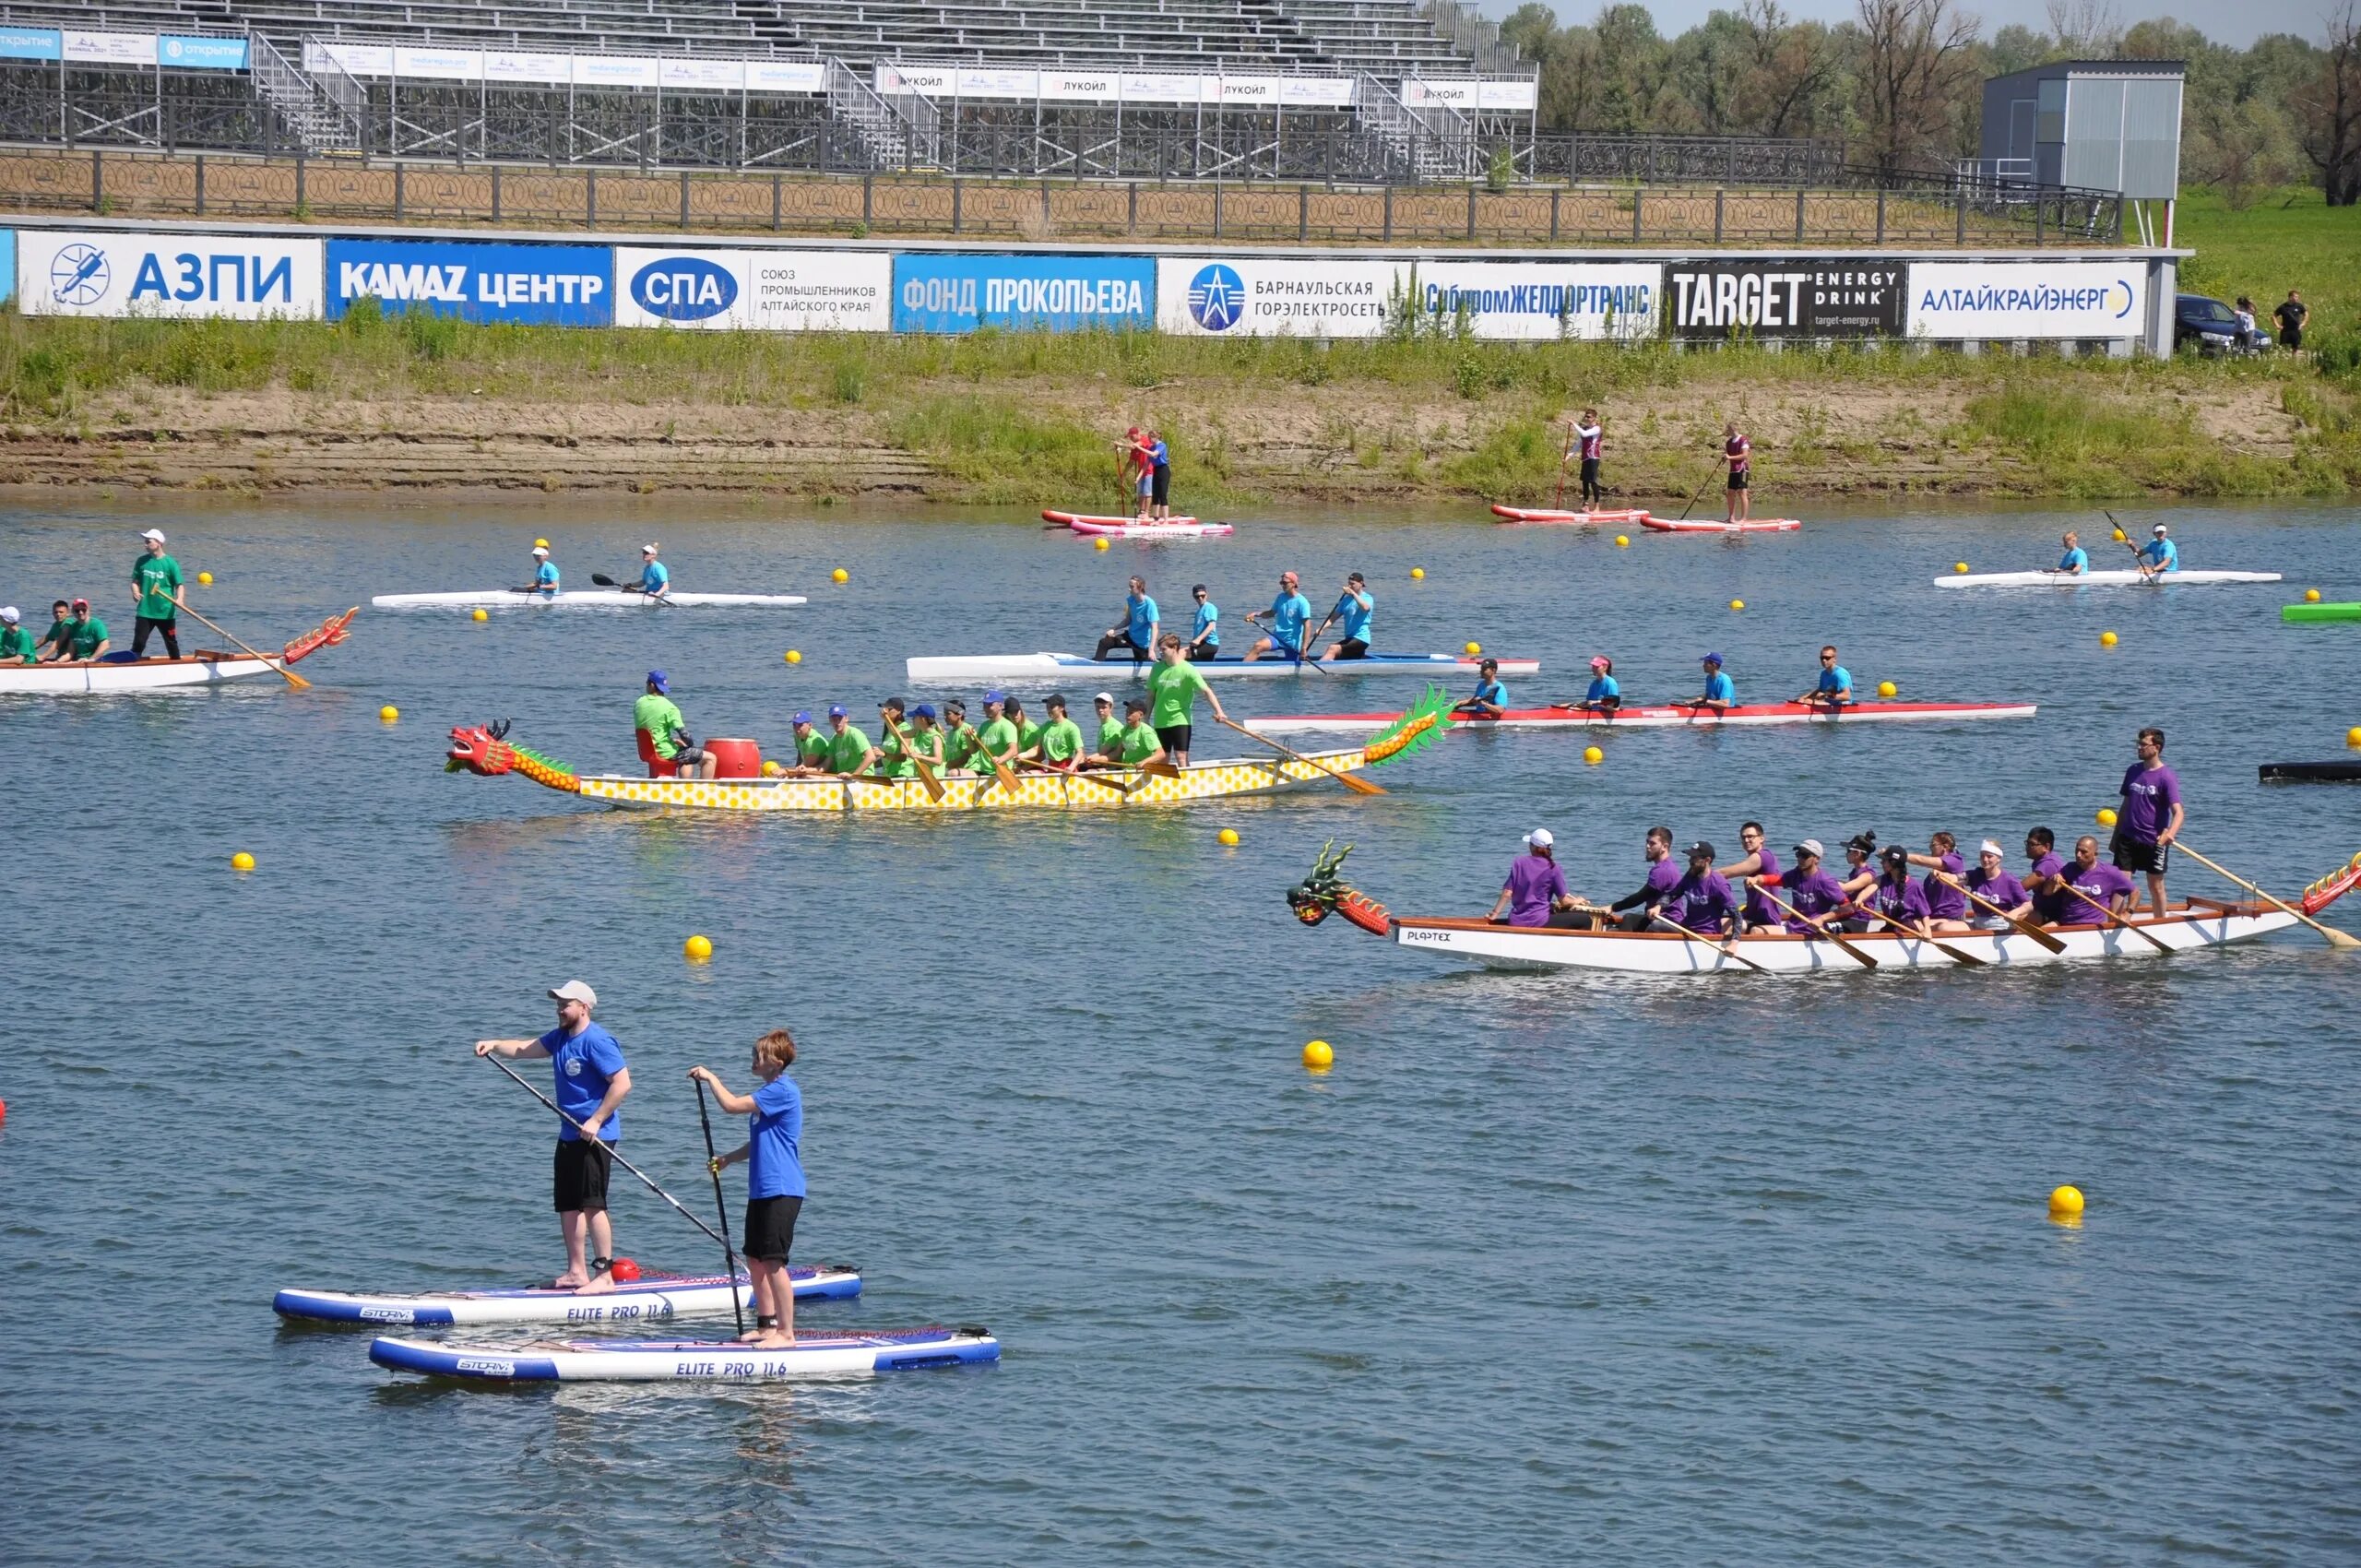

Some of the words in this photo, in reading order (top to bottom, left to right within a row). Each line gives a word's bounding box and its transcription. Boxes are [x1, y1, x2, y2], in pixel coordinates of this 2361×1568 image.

[0, 36, 53, 47] ткрытие
[184, 45, 243, 56] открытие
[1063, 80, 1107, 92] ЛУКОЙЛ
[1224, 84, 1266, 95] ЛУКОЙЛ
[130, 252, 291, 303] АЗПИ
[761, 268, 796, 280] СОЮЗ
[1816, 272, 1896, 286] ENERGY
[339, 261, 468, 302] KAMAZ
[478, 272, 603, 308] ЦЕНТР
[645, 271, 722, 306] СПА
[760, 285, 877, 297] ПРОМЫШЛЕННИКОВ
[1255, 280, 1373, 296] БАРНАУЛЬСКАЯ
[903, 278, 978, 317] ФОНД
[986, 279, 1144, 315] ПРОКОПЬЕВА
[760, 300, 836, 313] АЛТАЙСКОГО
[840, 303, 872, 313] КРАЯ
[1255, 302, 1385, 317] ГОРЭЛЕКТРОСЕТЬ
[1815, 315, 1880, 327] target-energy.ru
[362, 1309, 409, 1319] STORM
[567, 1308, 603, 1320] ELITE
[611, 1305, 639, 1320] PRO
[460, 1360, 509, 1371] STORM
[676, 1362, 715, 1375] ELITE
[724, 1362, 754, 1375] PRO
[764, 1361, 788, 1375] 11.6
